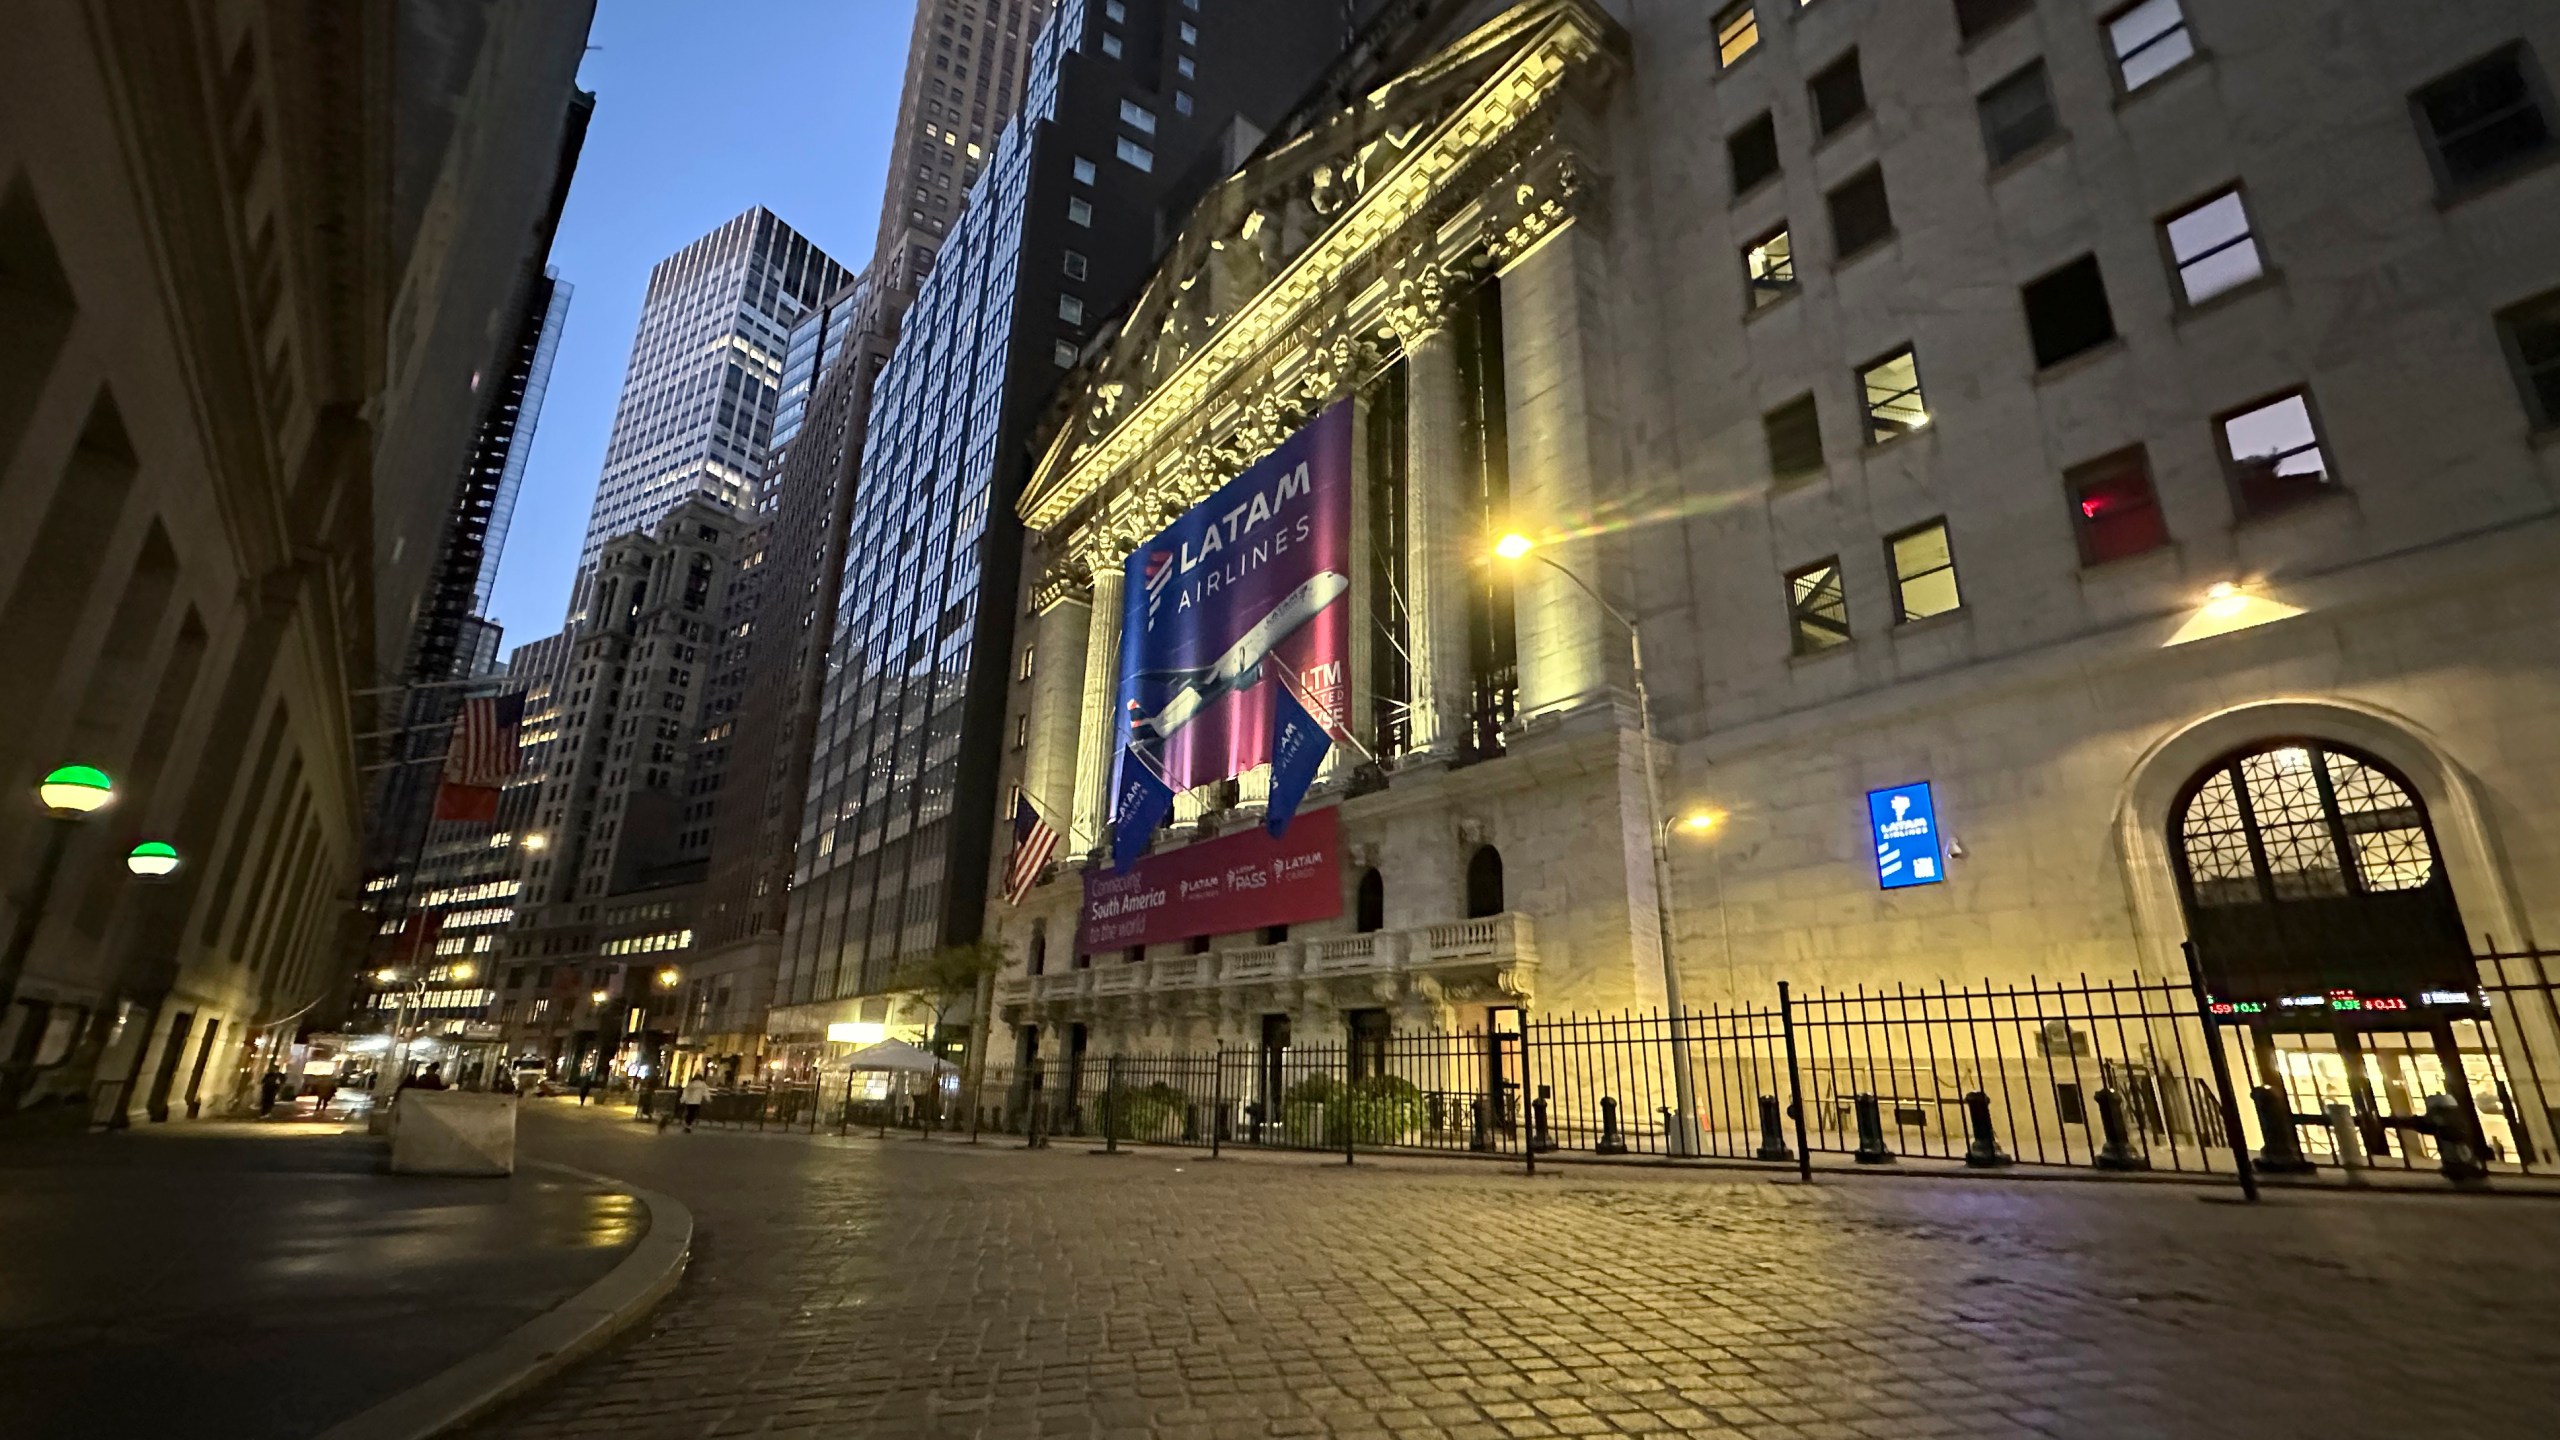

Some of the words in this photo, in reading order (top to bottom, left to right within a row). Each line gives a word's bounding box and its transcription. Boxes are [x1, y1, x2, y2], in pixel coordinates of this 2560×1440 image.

[1180, 461, 1311, 575] LATAM
[1178, 515, 1310, 614] AIRLINES
[1301, 660, 1342, 695] LTM
[1302, 689, 1344, 709] ISTED
[1310, 708, 1344, 730] YSE
[1881, 817, 1927, 833] LATAM
[1285, 851, 1323, 870] LATAM
[1092, 872, 1142, 898] Connecting
[1188, 876, 1219, 892] LATAM
[1236, 871, 1267, 891] PASS
[1092, 896, 1120, 920] South
[1121, 887, 1165, 914] America
[1089, 926, 1100, 944] to
[1100, 921, 1117, 941] the
[1119, 912, 1147, 938] world
